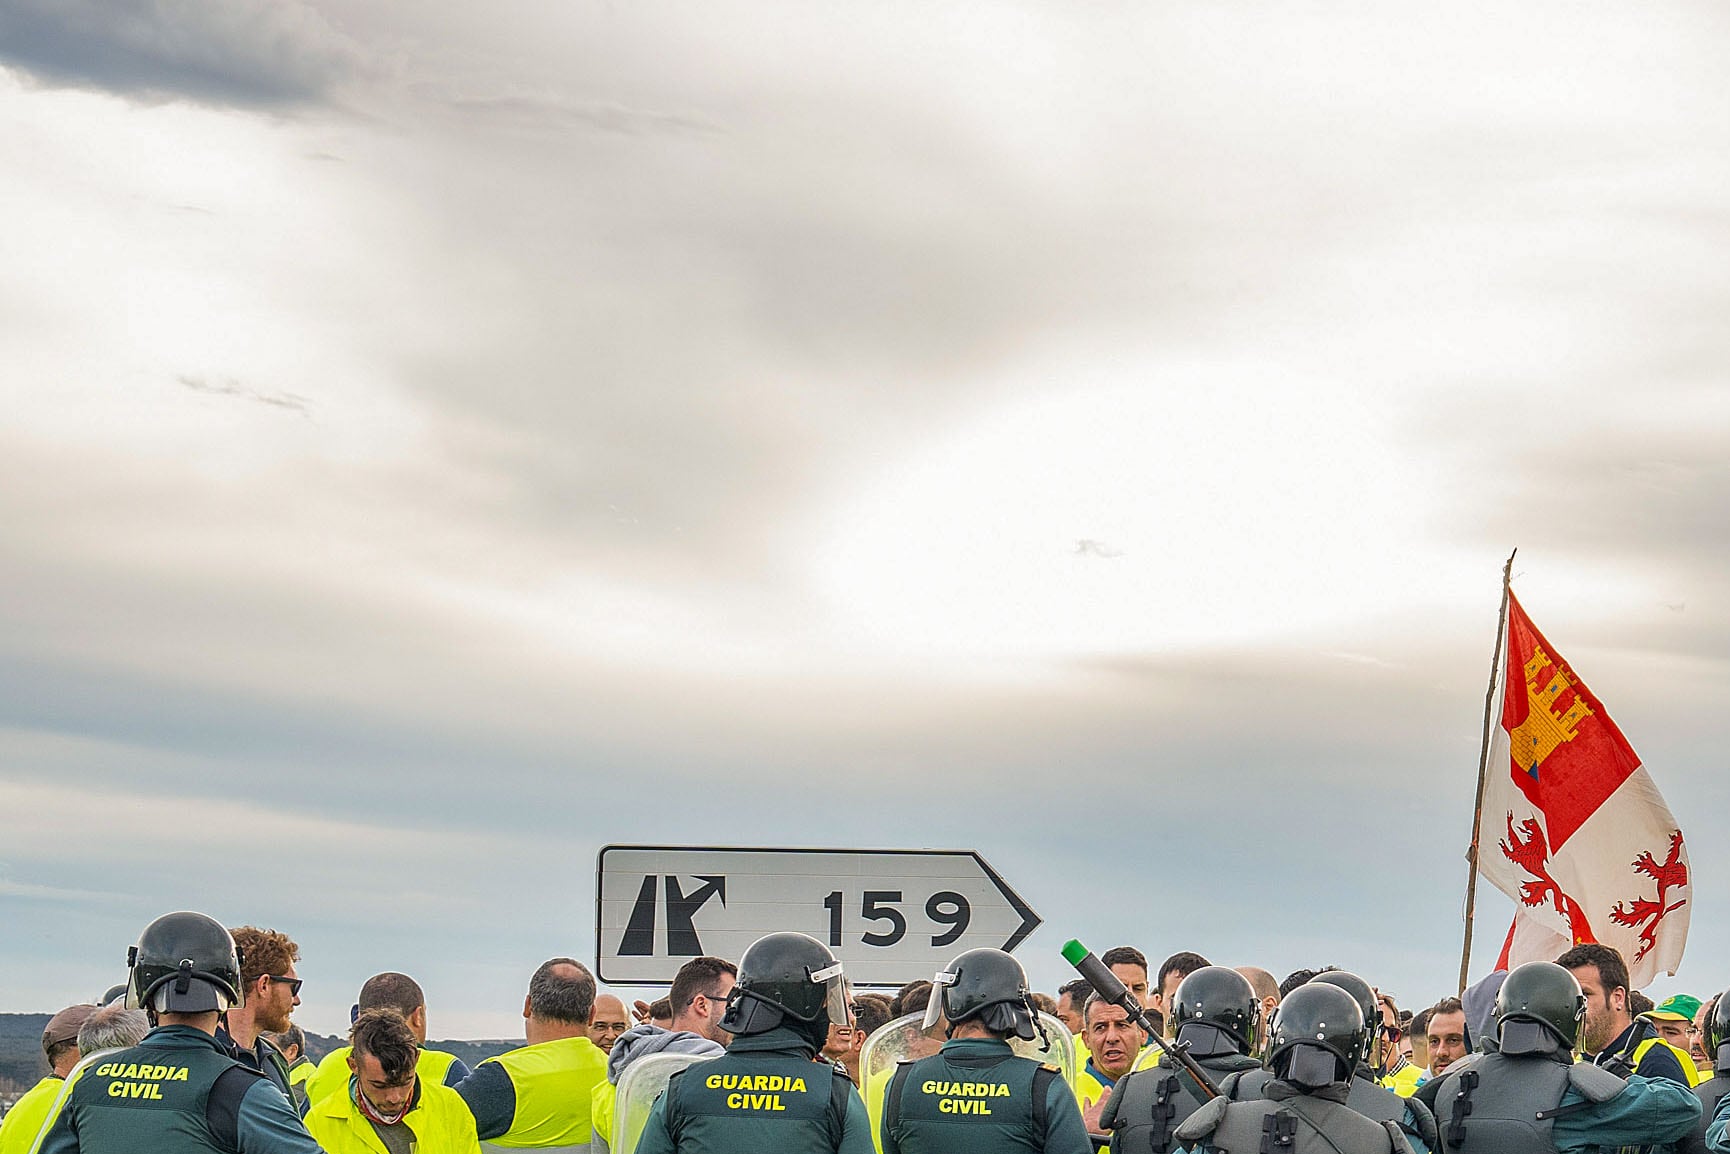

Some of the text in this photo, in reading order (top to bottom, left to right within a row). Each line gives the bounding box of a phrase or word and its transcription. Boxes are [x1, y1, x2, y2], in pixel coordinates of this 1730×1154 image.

[824, 891, 971, 947] 159
[96, 1063, 189, 1081] GUARDIA
[107, 1081, 163, 1100] CIVIL
[705, 1074, 807, 1093] GUARDIA
[922, 1080, 1011, 1097] GUARDIA
[726, 1093, 786, 1111] CIVIL
[938, 1098, 992, 1115] CIVIL
